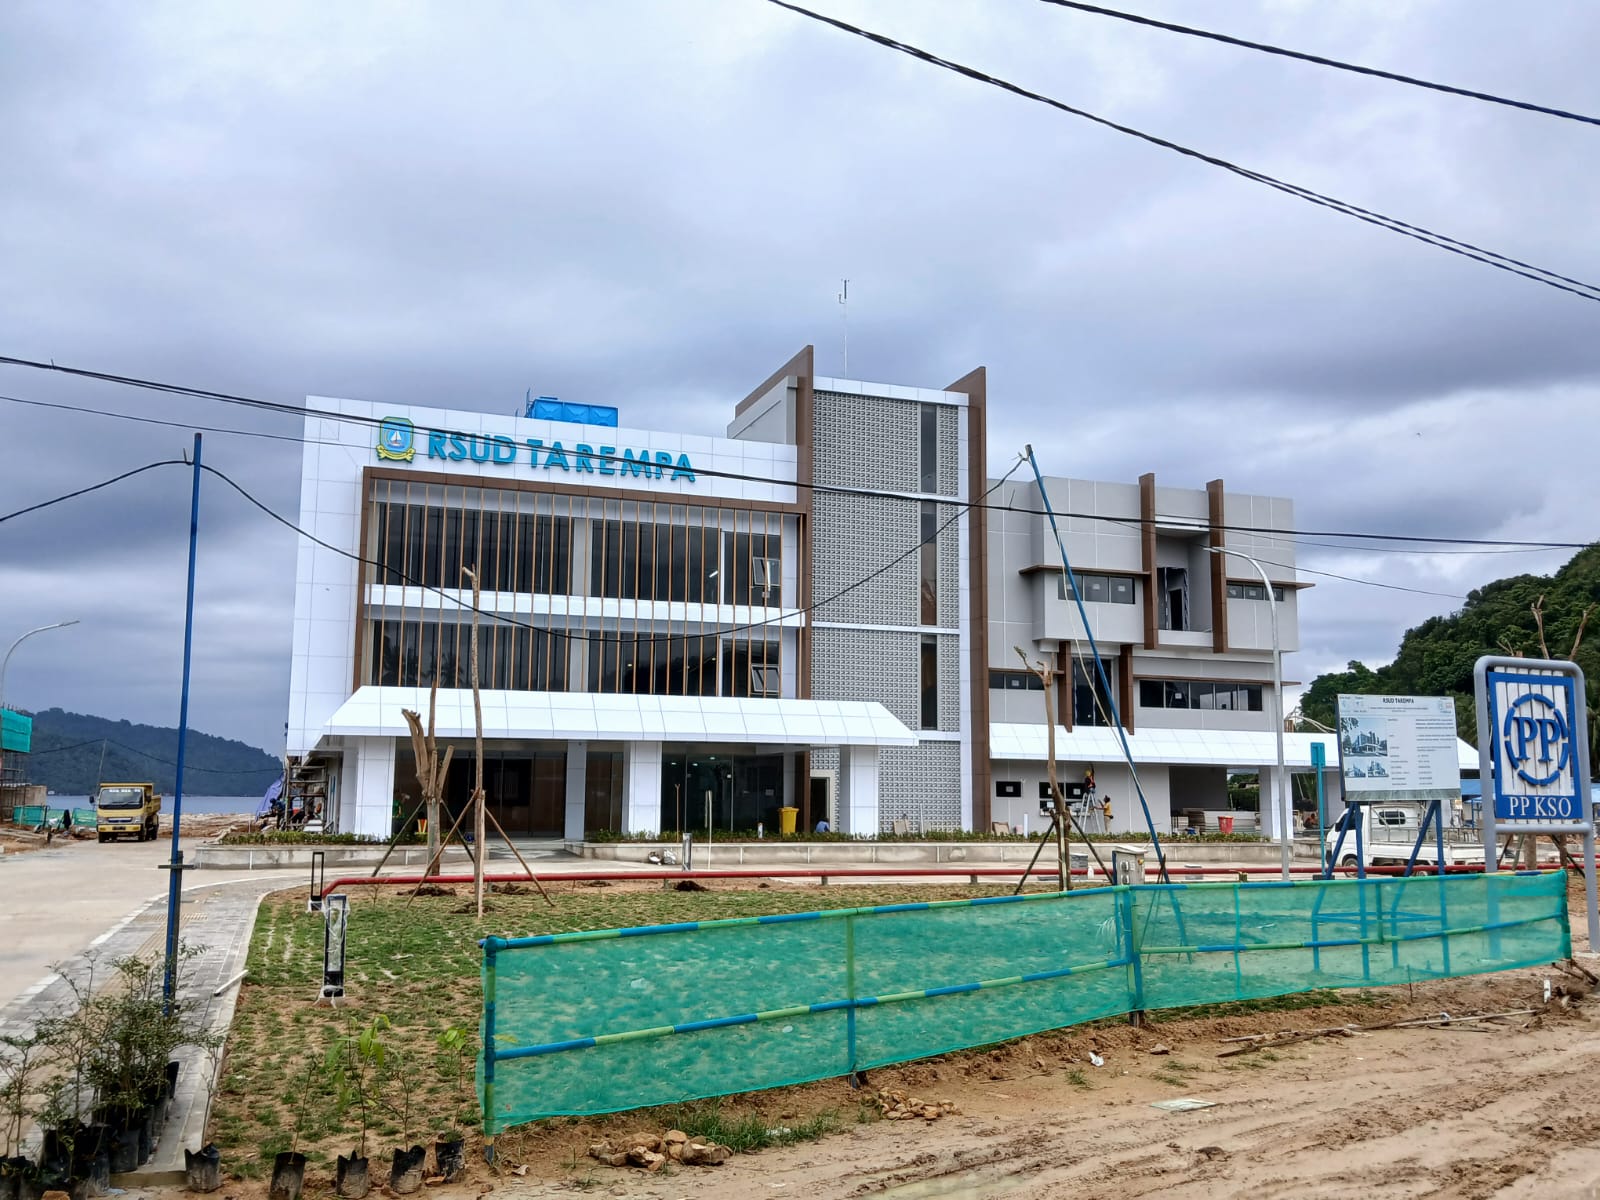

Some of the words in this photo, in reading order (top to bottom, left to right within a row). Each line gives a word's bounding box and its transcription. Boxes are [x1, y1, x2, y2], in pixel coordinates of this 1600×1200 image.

[428, 431, 517, 464] RSUD
[527, 439, 696, 482] TAREMPA
[1512, 716, 1560, 762] PP
[1509, 797, 1529, 816] PP
[1534, 797, 1571, 817] KSO
